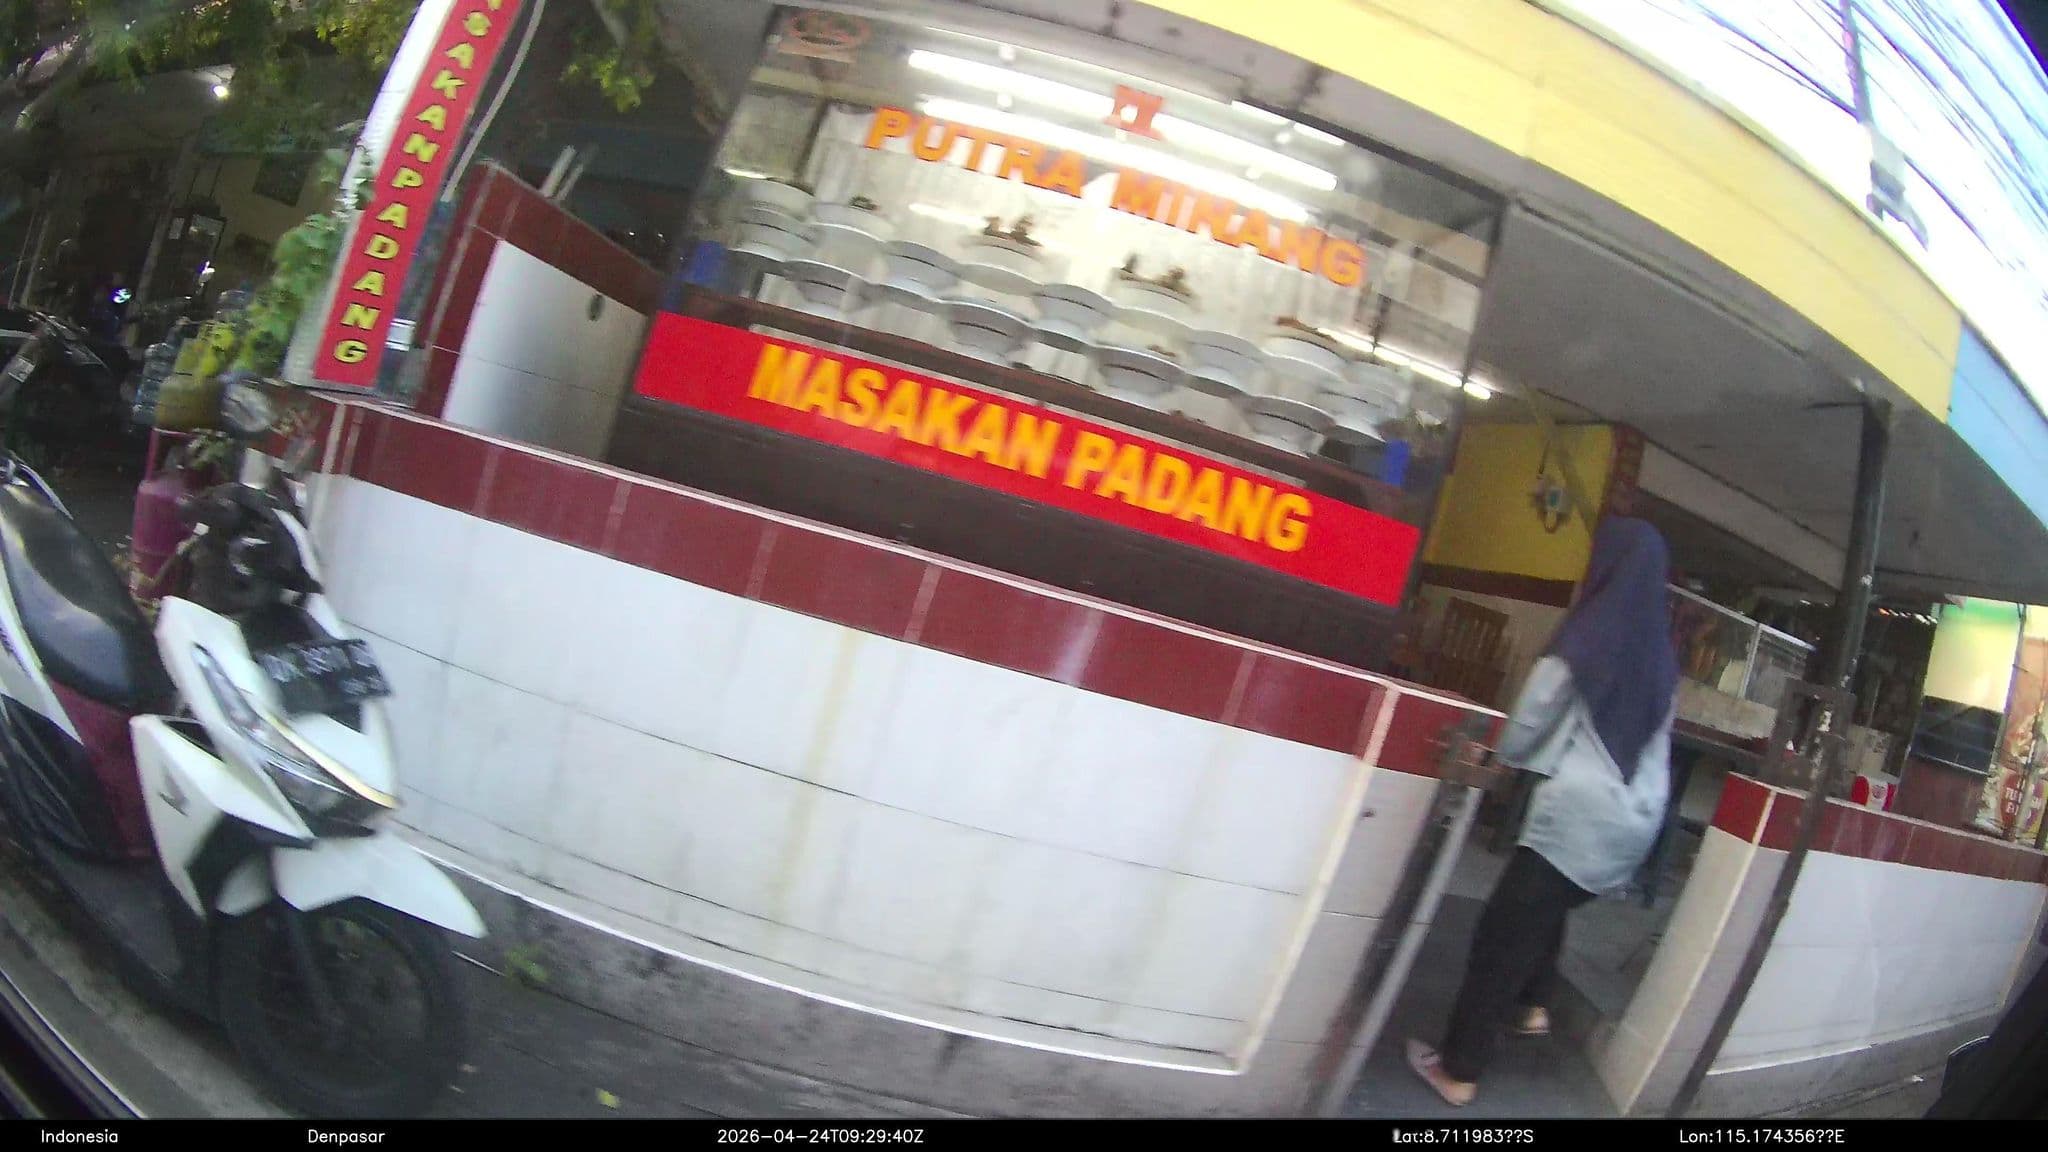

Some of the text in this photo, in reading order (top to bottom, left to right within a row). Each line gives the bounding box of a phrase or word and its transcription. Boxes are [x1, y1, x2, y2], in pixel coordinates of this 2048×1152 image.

[865, 106, 1367, 286] PUTRA MINANG
[747, 343, 1313, 552] MASAKAN PADANG
